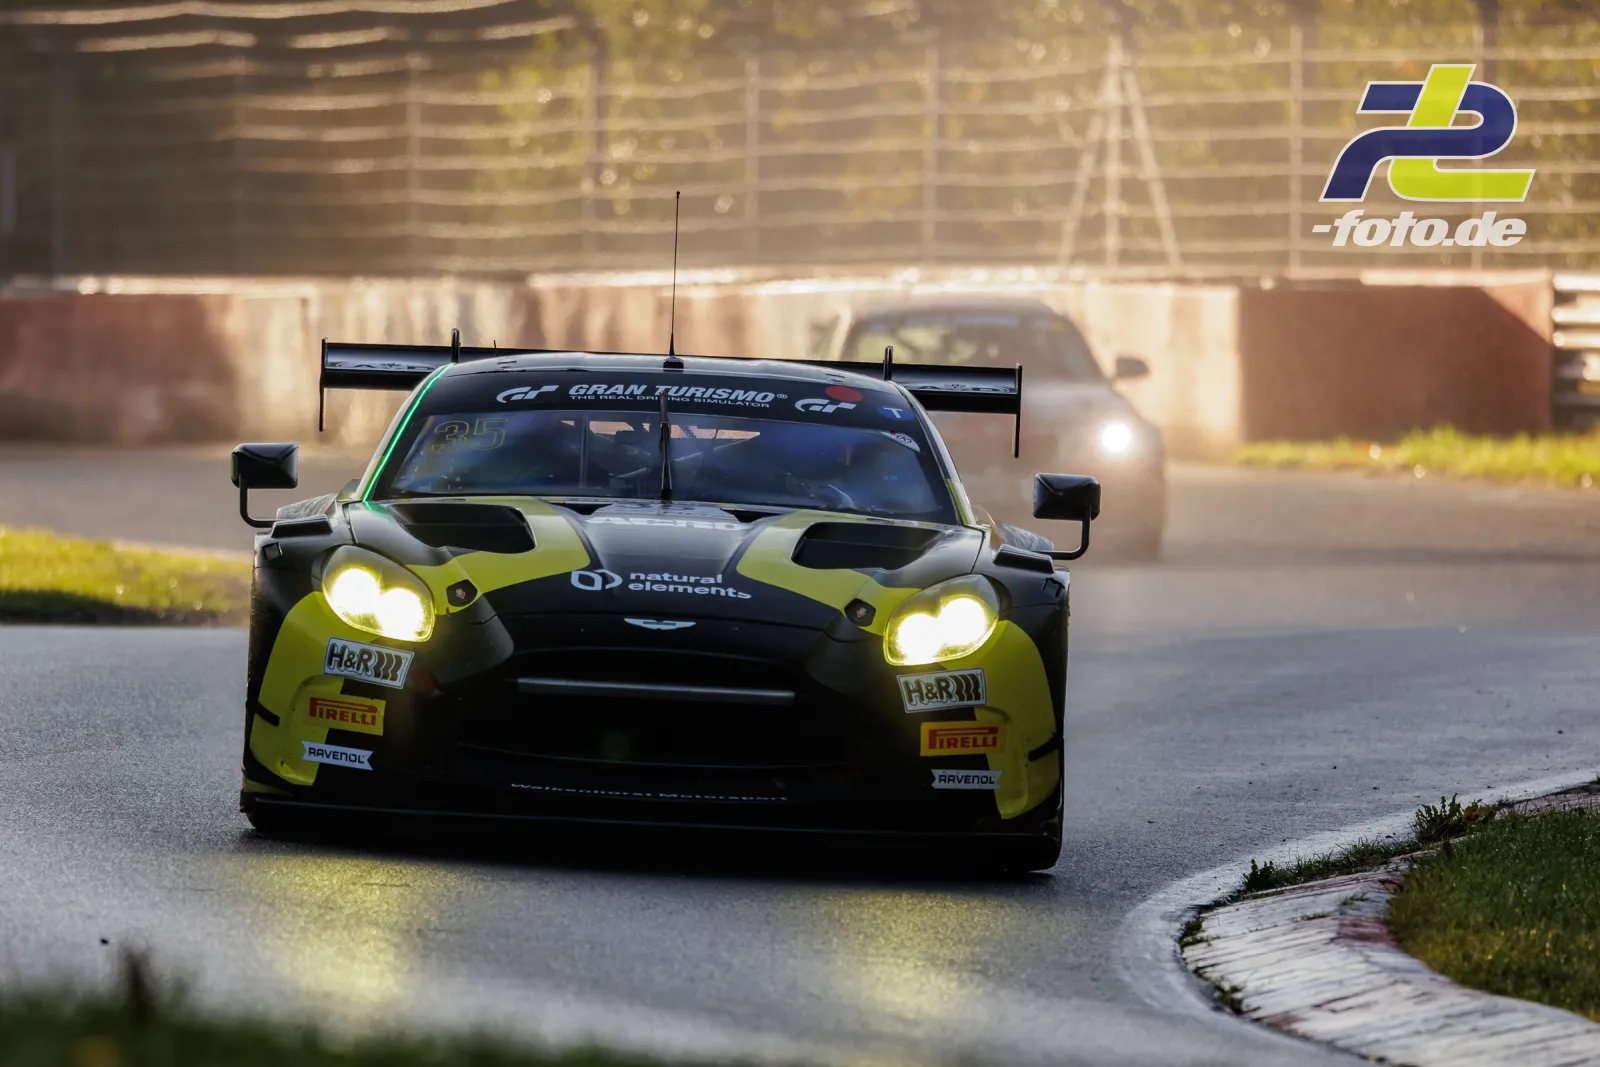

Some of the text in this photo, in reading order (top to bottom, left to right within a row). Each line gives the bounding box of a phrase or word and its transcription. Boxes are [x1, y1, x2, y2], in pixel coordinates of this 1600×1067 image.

[568, 384, 648, 396] GRAN
[693, 397, 770, 408] SIMULATOR
[883, 407, 903, 419] T
[431, 418, 509, 455] 35
[629, 572, 723, 584] natural
[627, 582, 752, 599] elements
[326, 642, 374, 677] H&R
[902, 676, 955, 706] H&R
[309, 697, 378, 727] PIRELLI
[928, 726, 999, 749] PIRELLI
[308, 747, 365, 764] RAVENOL
[938, 774, 996, 785] RAVENOL
